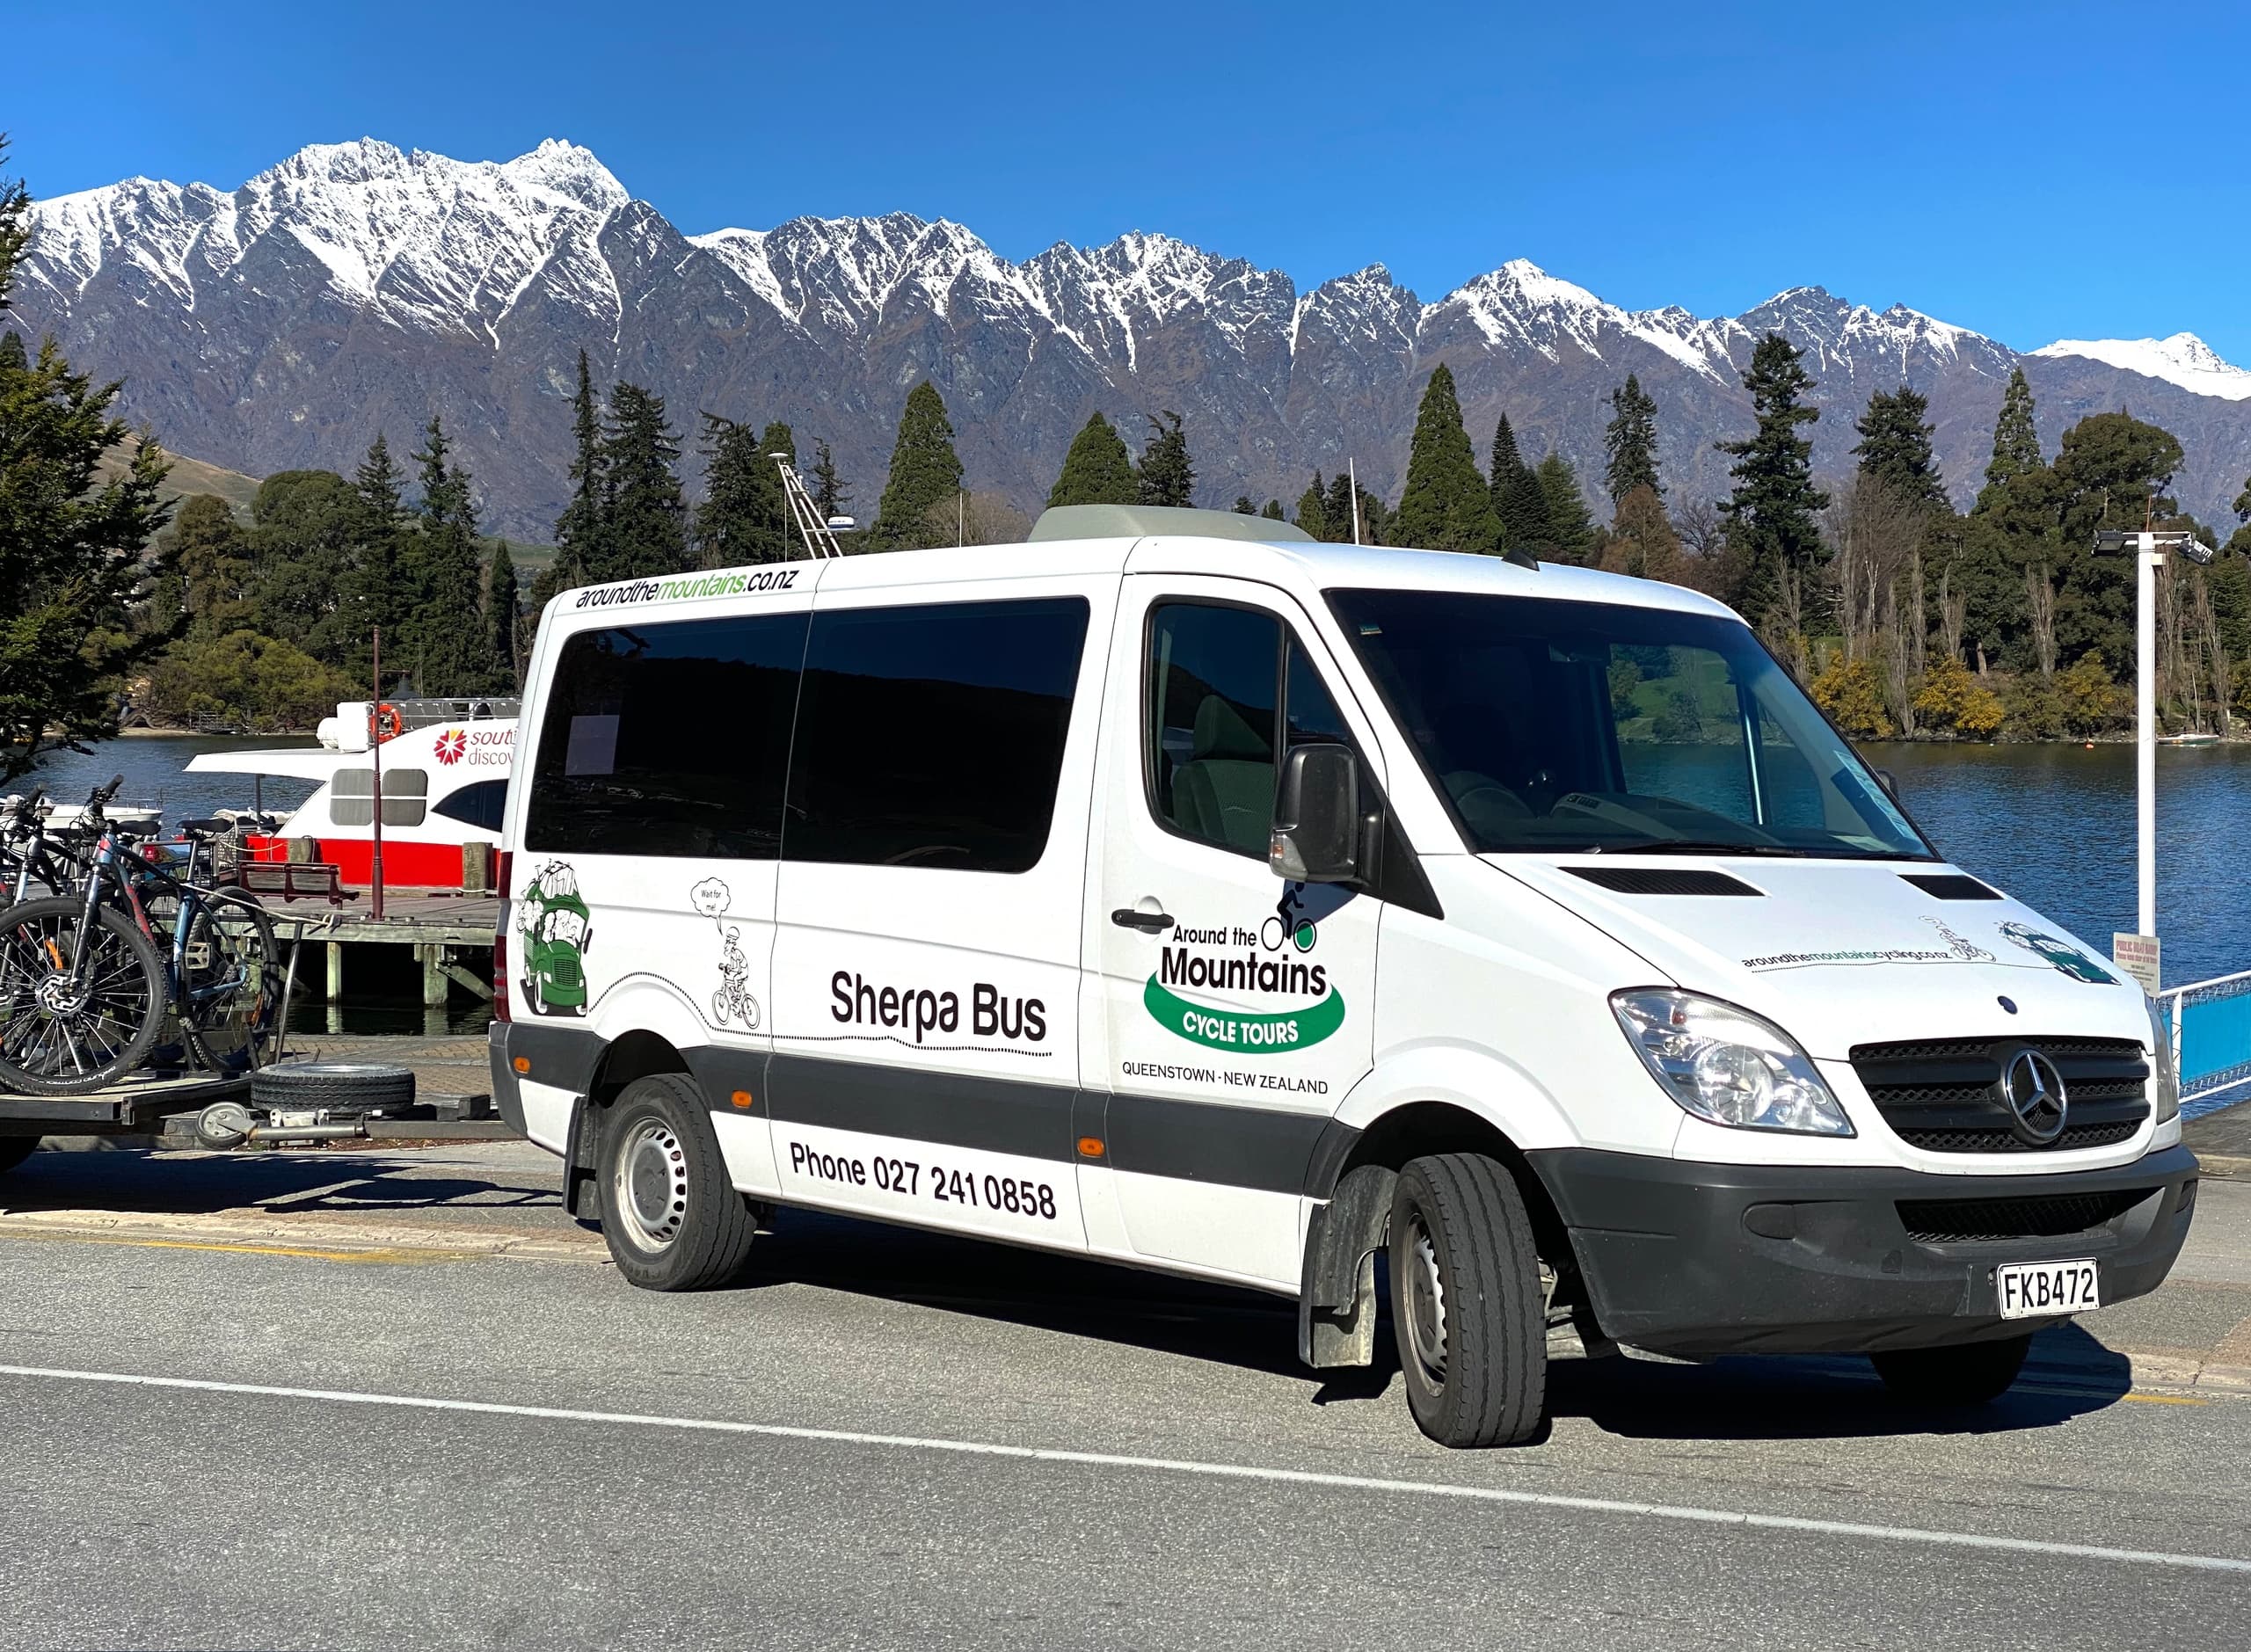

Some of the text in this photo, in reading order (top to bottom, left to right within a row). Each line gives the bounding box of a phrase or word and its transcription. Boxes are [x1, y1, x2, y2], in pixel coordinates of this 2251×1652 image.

[576, 570, 799, 608] aroundthemountains.co.nz
[1172, 924, 1257, 947] Around the
[1161, 946, 1326, 996] Mountains
[831, 971, 1046, 1044] Sherpa Bus
[1183, 1011, 1299, 1044] CYCLE TOURS
[1122, 1061, 1215, 1083] QUEENSTOWN
[1224, 1072, 1257, 1087] NEW
[1259, 1074, 1329, 1095] ZEALAND
[790, 1142, 1057, 1220] Phone 027 241 0858
[2005, 1268, 2094, 1309] FKB472
